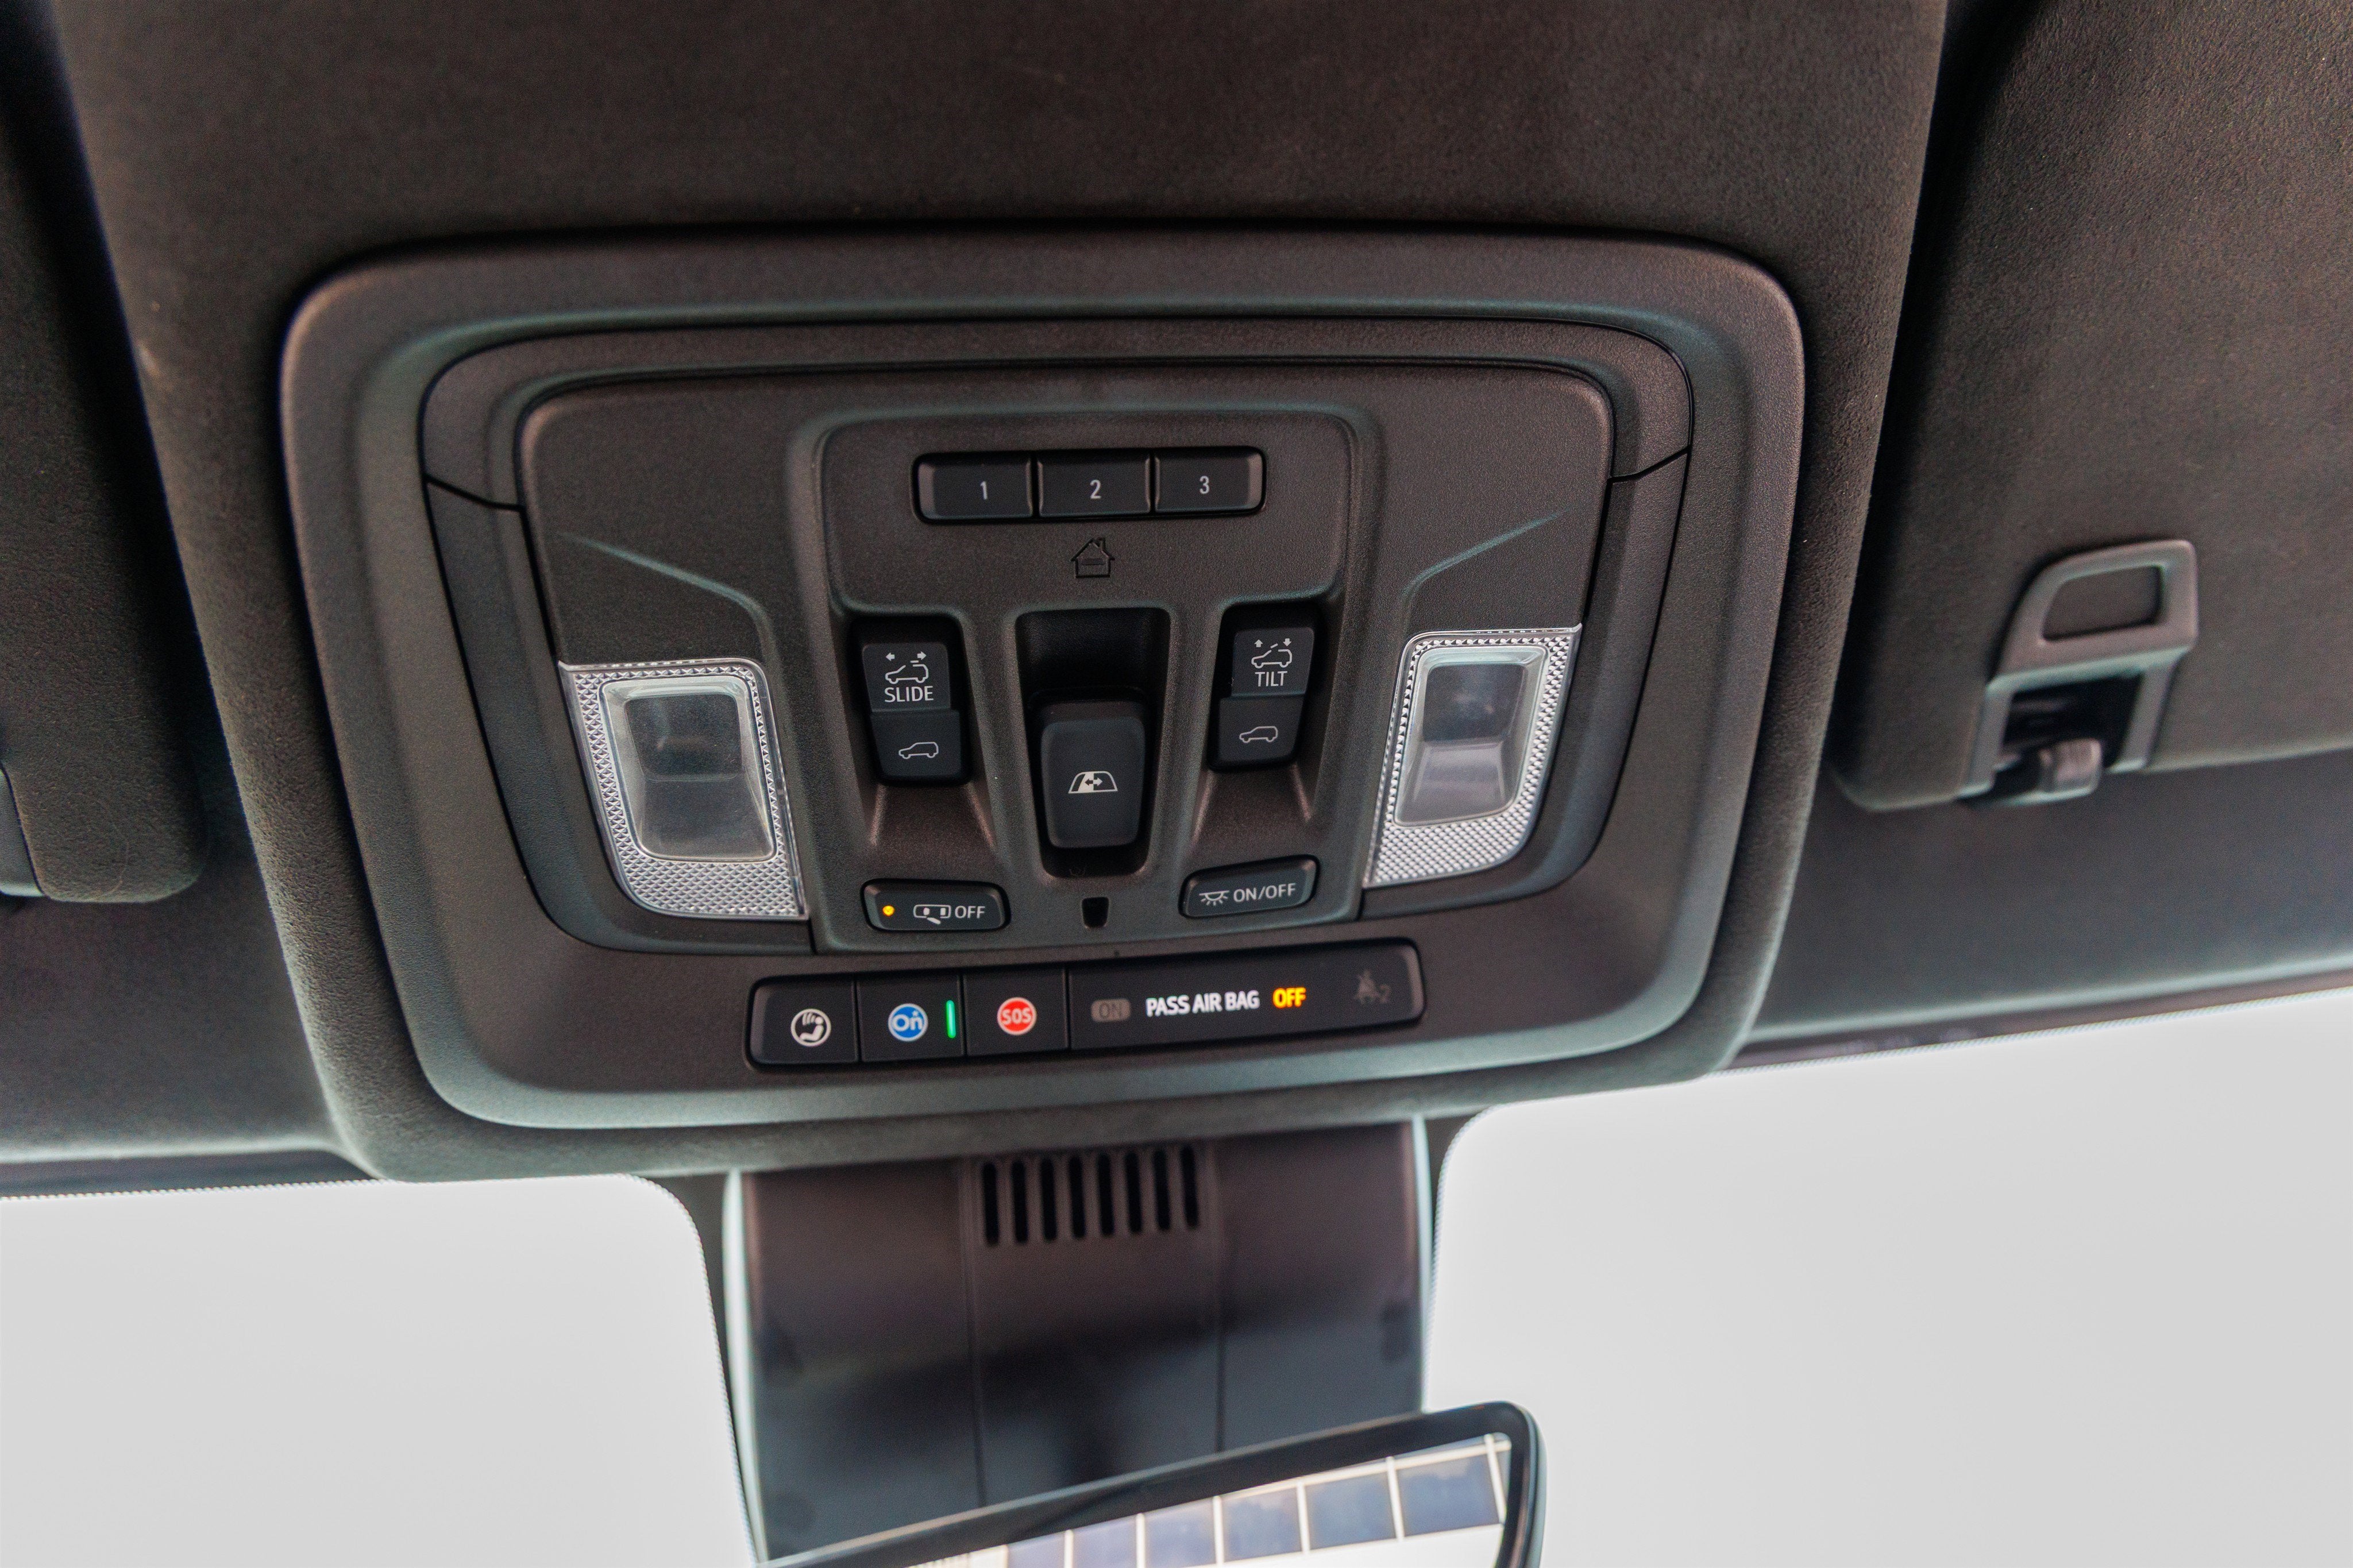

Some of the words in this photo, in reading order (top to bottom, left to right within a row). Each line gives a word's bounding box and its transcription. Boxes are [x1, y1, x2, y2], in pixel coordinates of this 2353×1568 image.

[980, 481, 988, 500] 1
[1090, 480, 1101, 500] 2
[1199, 476, 1210, 495] 3
[1255, 671, 1288, 687] TILT
[884, 686, 934, 702] SLIDE
[1233, 883, 1296, 902] ON/OFF
[954, 905, 985, 919] OFF
[1146, 995, 1190, 1017] PASS
[1192, 992, 1222, 1013] AIR
[1225, 990, 1260, 1011] BAG
[1272, 987, 1306, 1008] OFF
[1001, 1008, 1032, 1025] SOS
